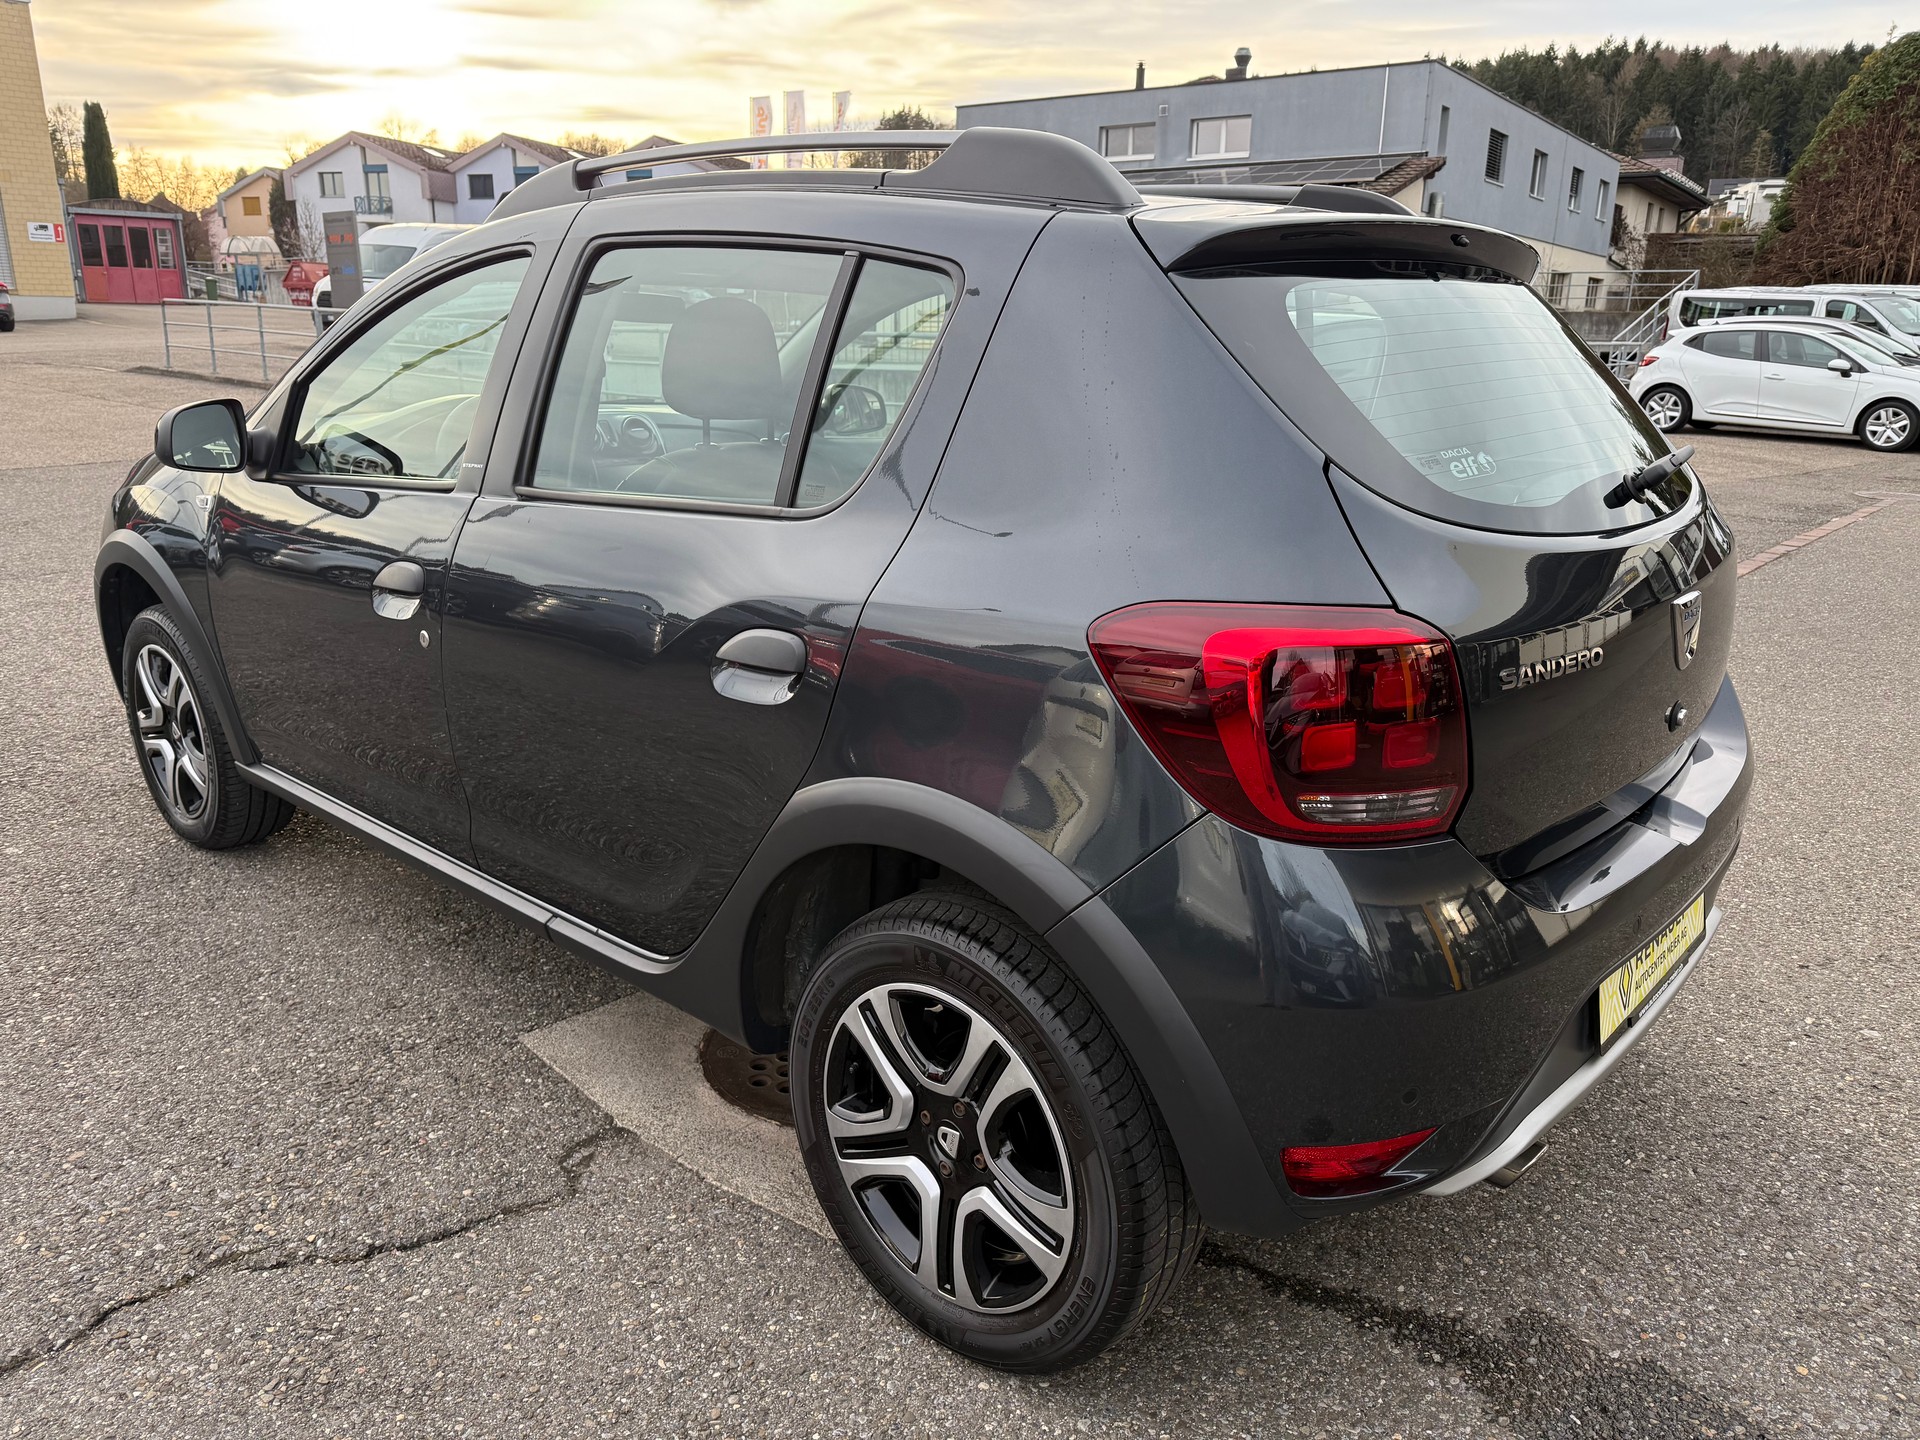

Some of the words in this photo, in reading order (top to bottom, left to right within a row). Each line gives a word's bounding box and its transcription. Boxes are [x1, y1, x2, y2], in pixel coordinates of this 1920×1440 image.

[1440, 447, 1471, 459] DACIA
[1449, 456, 1479, 478] elf
[1500, 647, 1604, 691] SANDERO
[1634, 953, 1667, 993] AUTOCENTER
[1680, 926, 1688, 942] AG
[945, 959, 1070, 1088] MICHELIN
[1047, 1275, 1097, 1339] ENERGY
